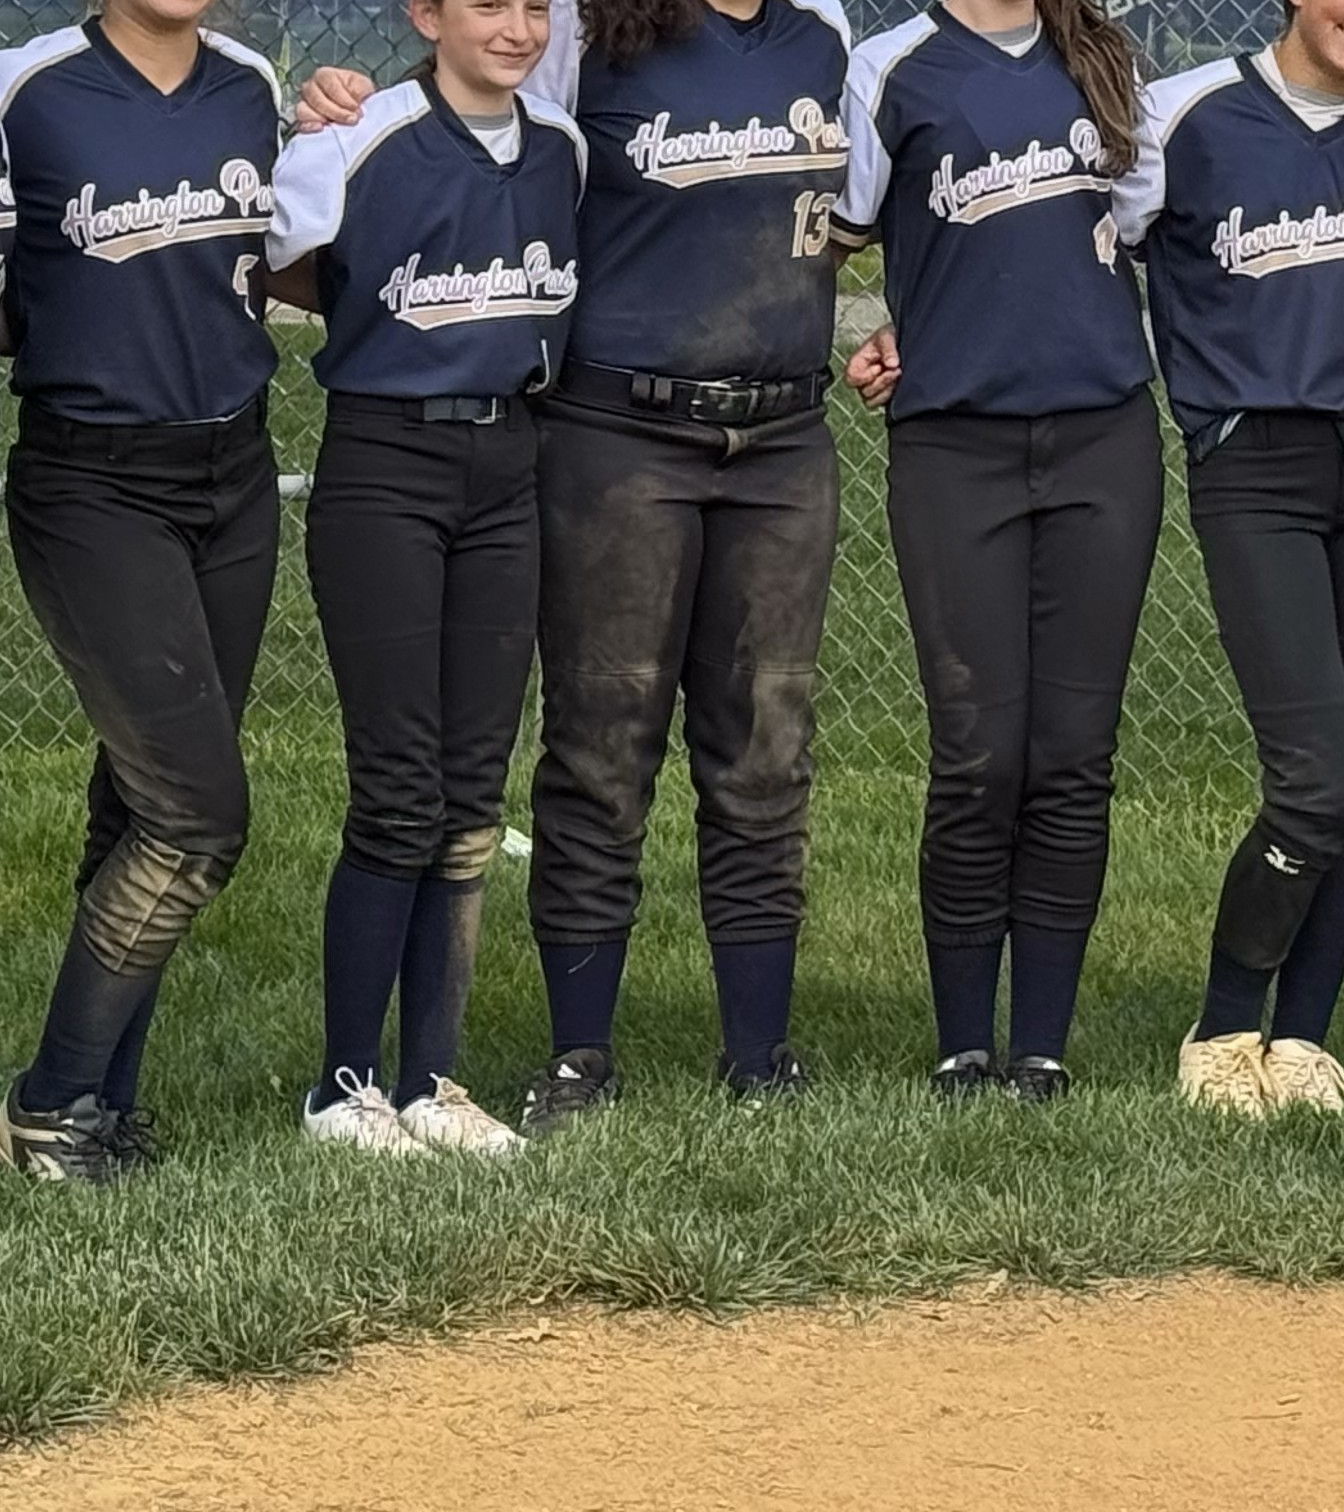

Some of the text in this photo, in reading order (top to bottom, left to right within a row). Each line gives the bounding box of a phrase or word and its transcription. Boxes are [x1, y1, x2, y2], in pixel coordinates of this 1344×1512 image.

[626, 111, 795, 175] Harrington
[61, 158, 275, 250] Harrington Pa
[929, 139, 1074, 219] Harrington
[791, 190, 838, 258] 13
[379, 252, 528, 313] Harrington
